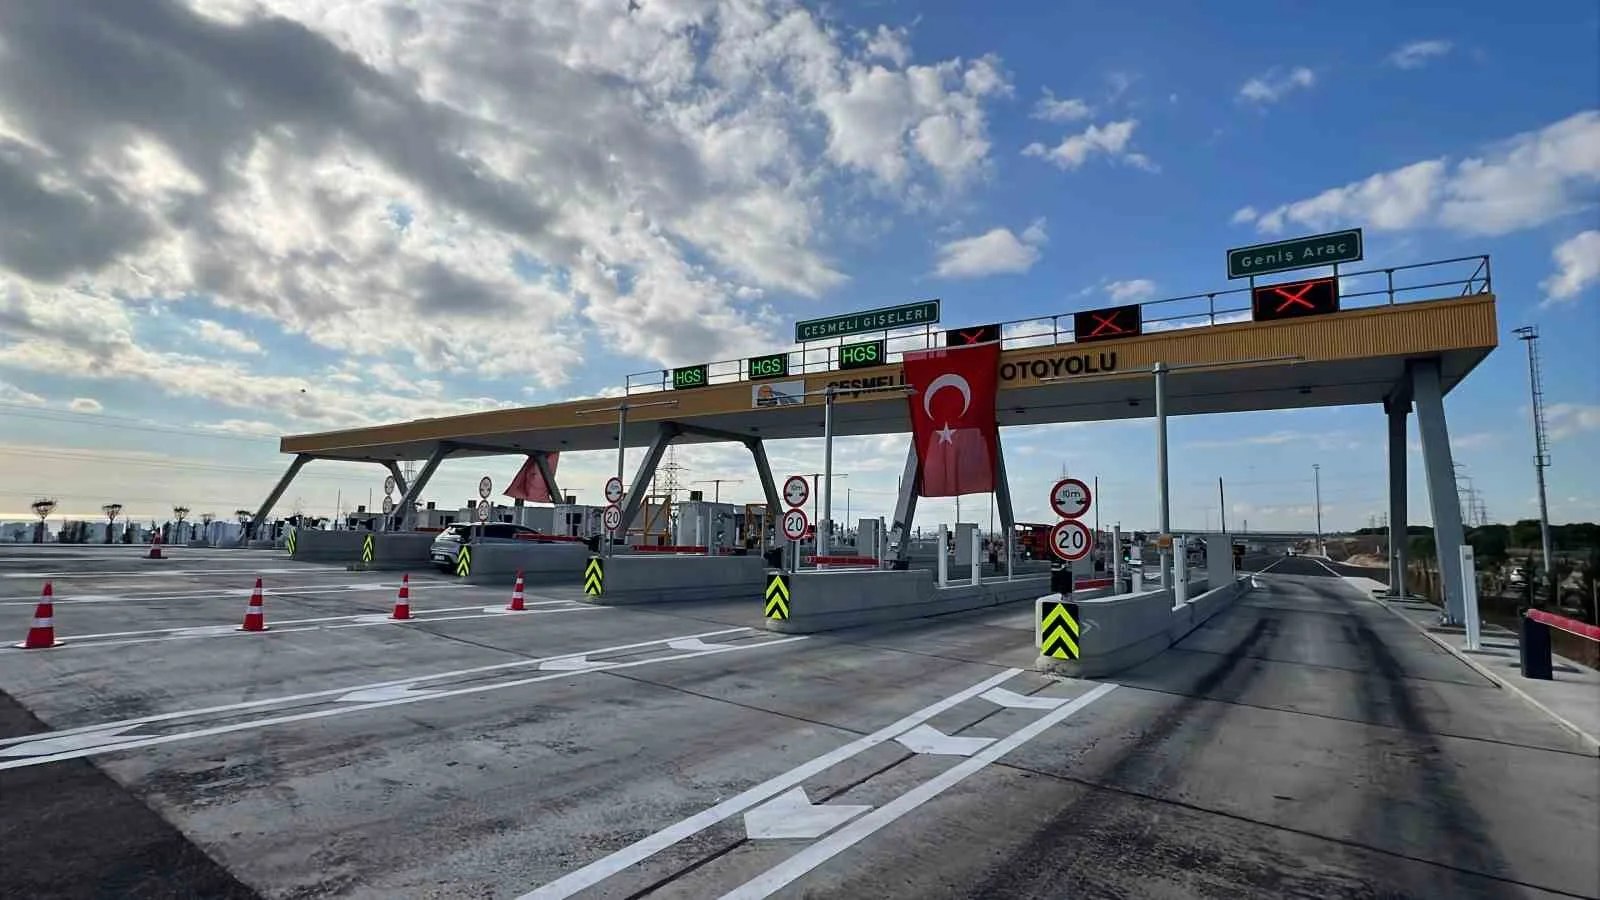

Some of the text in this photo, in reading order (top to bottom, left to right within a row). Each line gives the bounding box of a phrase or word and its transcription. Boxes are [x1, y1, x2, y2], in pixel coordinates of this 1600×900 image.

[1302, 242, 1347, 260] Araç
[803, 305, 929, 338] ÇEŞMELİ GİŞELERİ
[842, 345, 877, 364] HGS
[751, 359, 781, 375] HGS
[1000, 351, 1117, 381] OTOYOLU
[676, 369, 702, 385] HGS
[606, 511, 619, 524] 20
[787, 516, 803, 531] 20
[1058, 530, 1084, 549] 20
